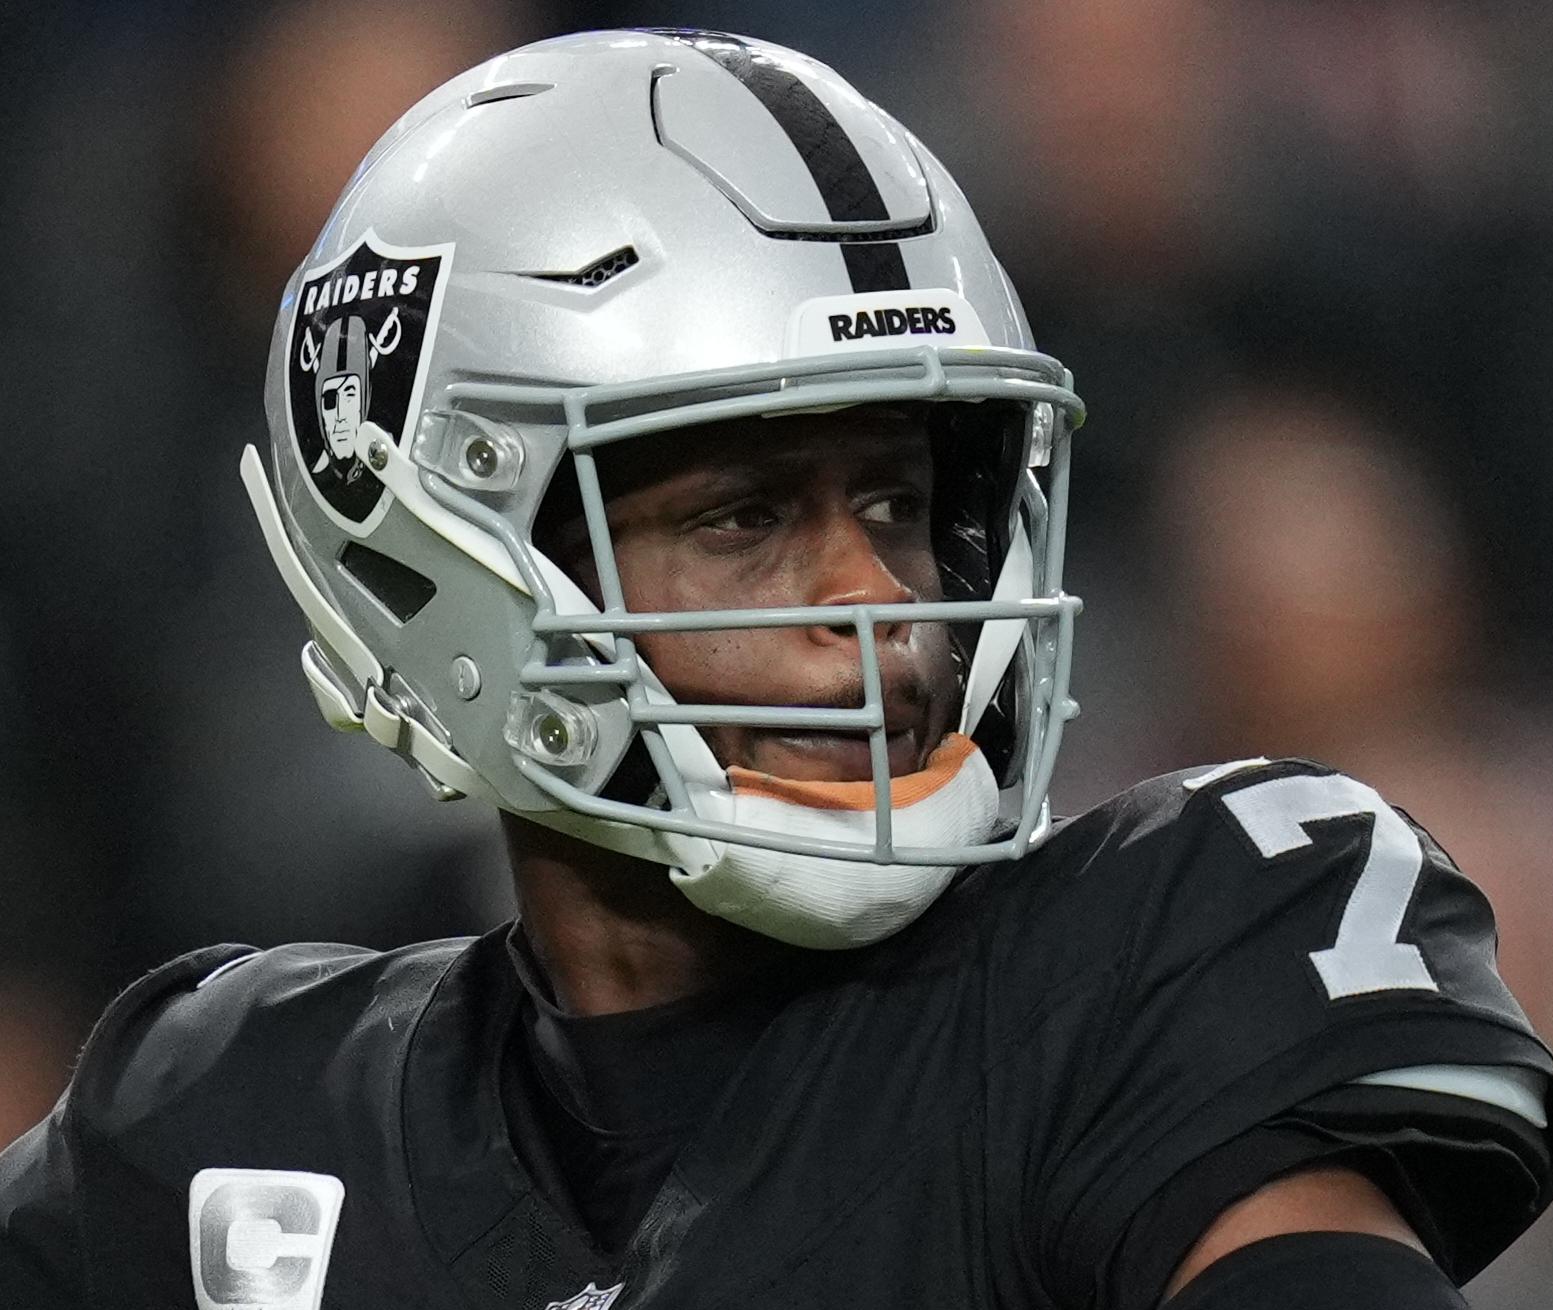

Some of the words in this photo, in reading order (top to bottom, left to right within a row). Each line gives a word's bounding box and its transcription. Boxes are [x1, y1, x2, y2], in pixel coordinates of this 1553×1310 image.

[304, 266, 420, 315] RAIDERS
[828, 307, 955, 342] RAIDERS
[1221, 775, 1439, 1000] 7
[199, 1183, 321, 1304] C
